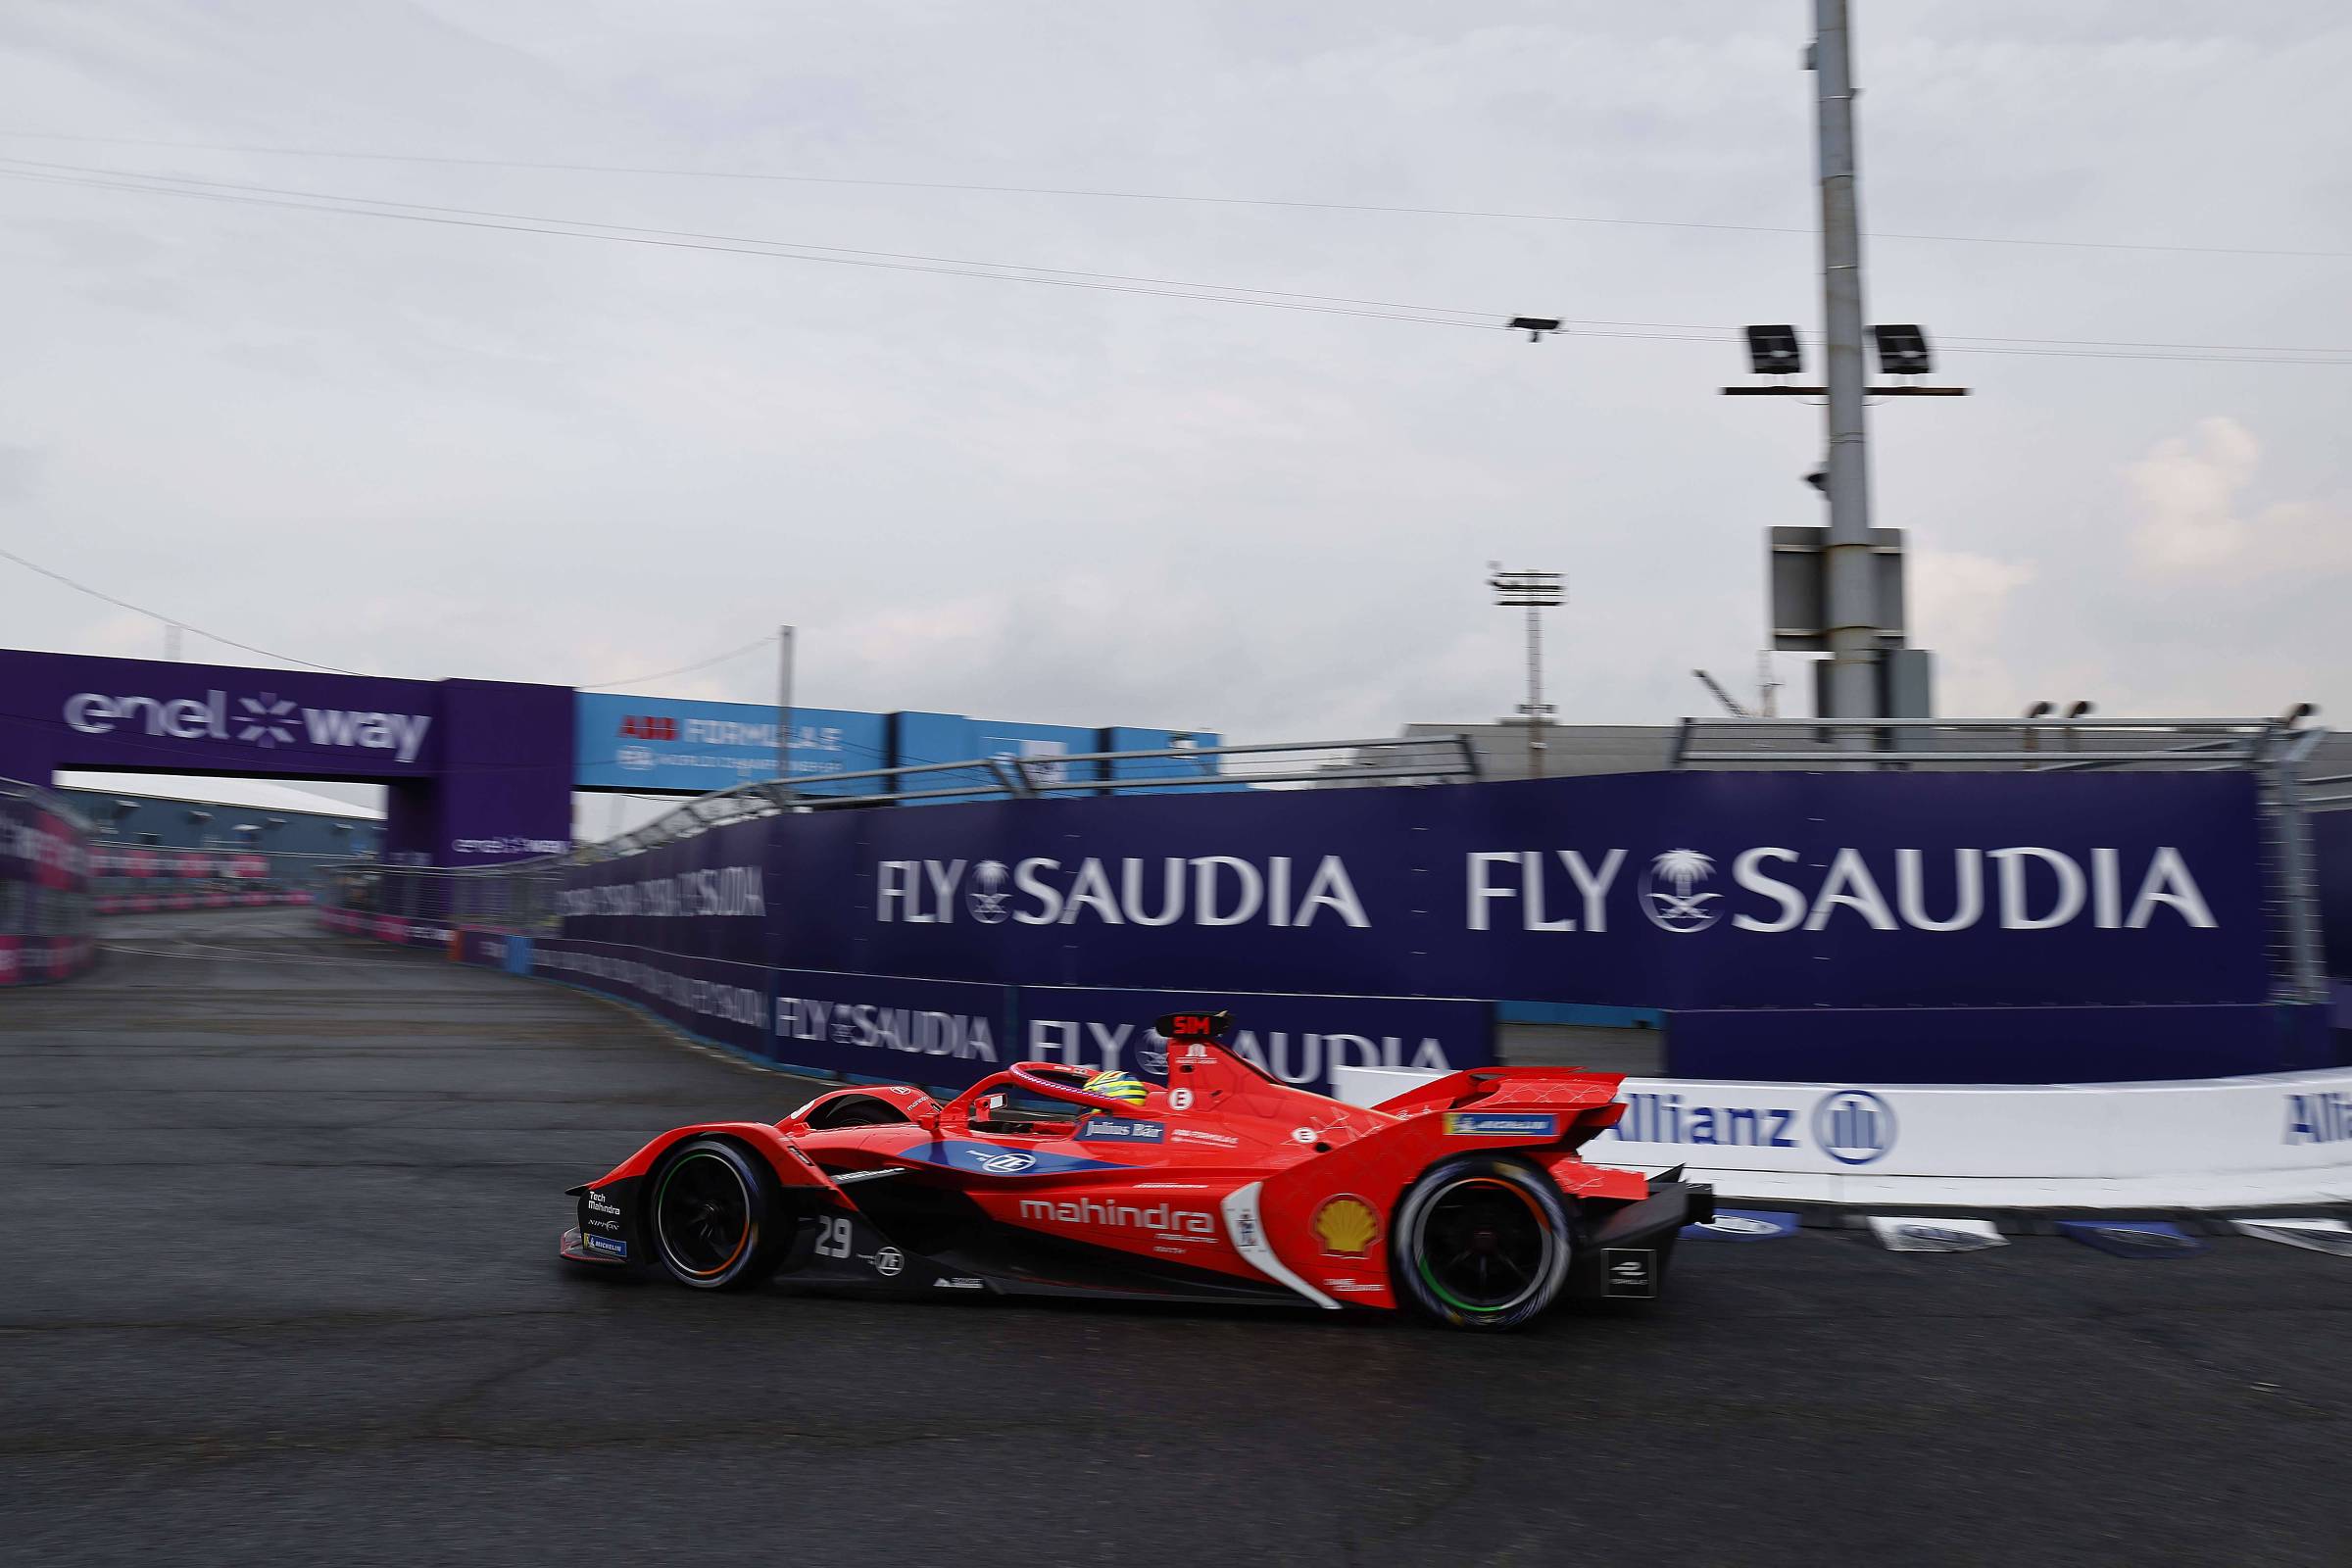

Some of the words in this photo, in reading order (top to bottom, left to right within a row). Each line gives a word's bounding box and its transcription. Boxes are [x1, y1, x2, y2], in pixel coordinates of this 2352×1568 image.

[63, 689, 230, 739] enel
[301, 708, 433, 762] way
[876, 858, 968, 924] FLY
[1011, 856, 1372, 928] SAUDIA
[1465, 848, 1629, 933] FLY
[1730, 846, 2219, 933] SAUDIA
[775, 997, 834, 1041] FLY
[851, 1004, 999, 1062] SAUDIA
[1173, 1015, 1210, 1035] SIM
[1028, 1019, 1135, 1072] FLY
[1232, 1027, 1451, 1085] AUDIA
[588, 1200, 620, 1215] Mahindra
[589, 1191, 606, 1202] Tech
[1019, 1197, 1215, 1233] mahindra
[595, 1241, 621, 1252] MICHELIN
[814, 1214, 852, 1258] 29
